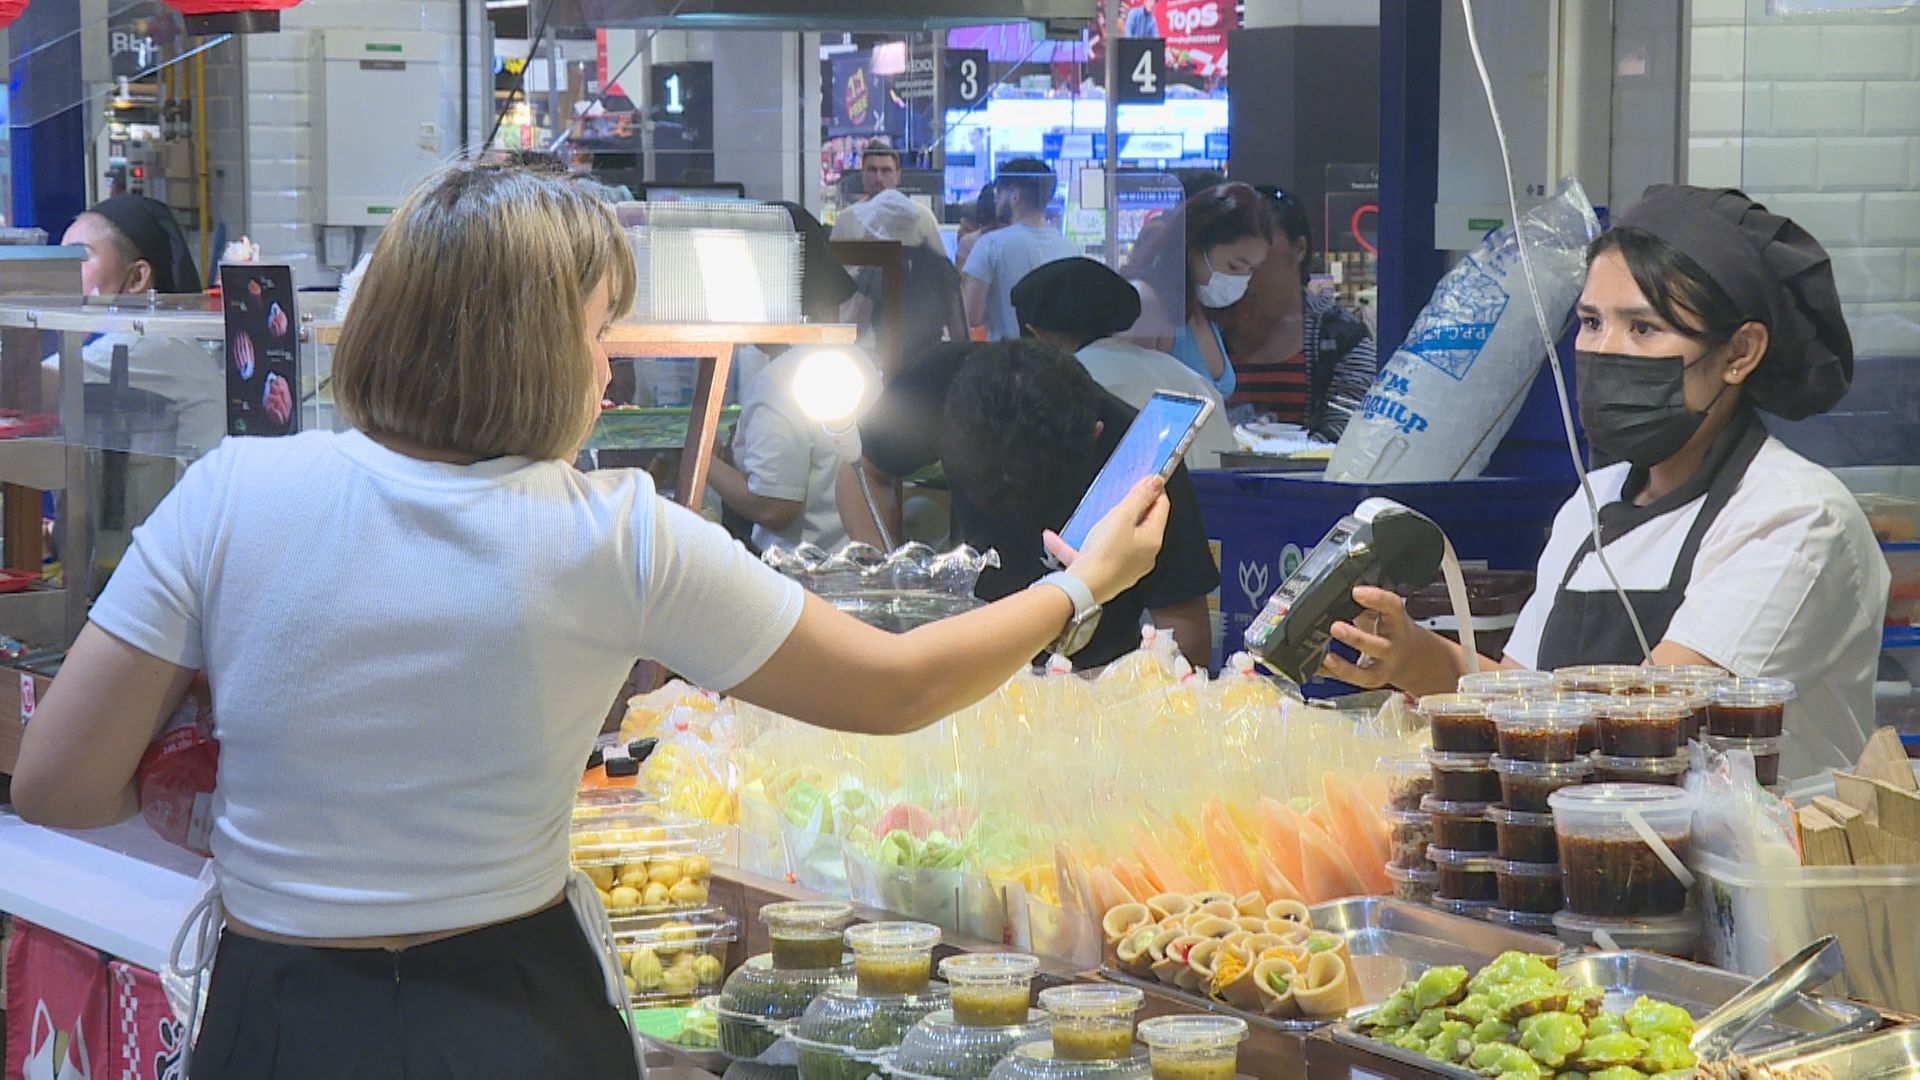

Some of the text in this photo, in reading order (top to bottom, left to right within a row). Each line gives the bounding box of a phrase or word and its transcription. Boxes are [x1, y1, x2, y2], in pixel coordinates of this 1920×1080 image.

[1166, 3, 1219, 35] Tops
[961, 59, 978, 100] 3
[1132, 50, 1157, 93] 4
[666, 74, 685, 114] 1
